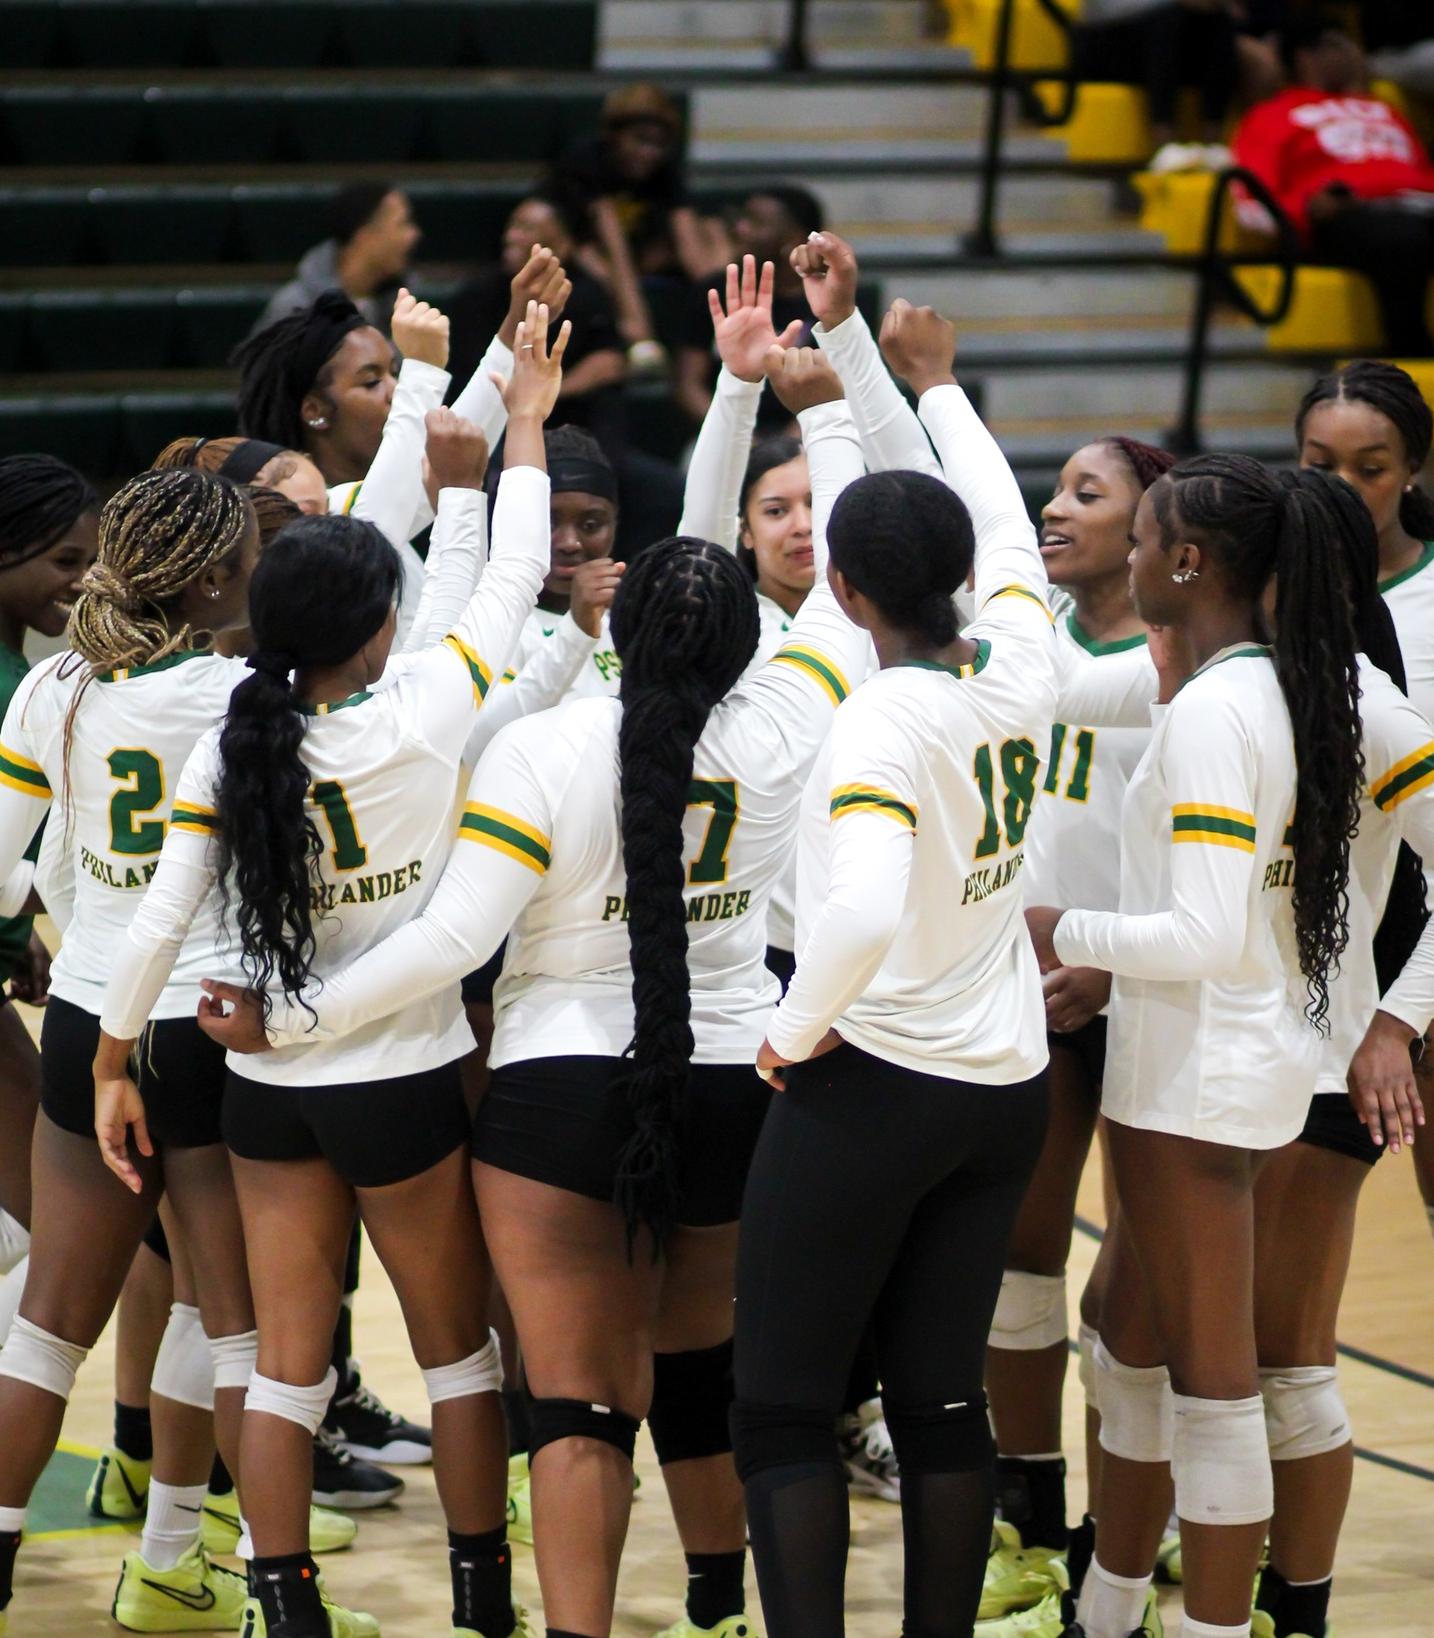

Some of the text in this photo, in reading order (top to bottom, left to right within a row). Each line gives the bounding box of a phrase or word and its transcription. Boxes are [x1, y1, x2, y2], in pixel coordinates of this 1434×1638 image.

[106, 747, 166, 856] 2
[311, 779, 369, 872] 1
[973, 736, 1040, 861] 18
[601, 889, 752, 921] PNDER
[1262, 859, 1295, 891] PHI
